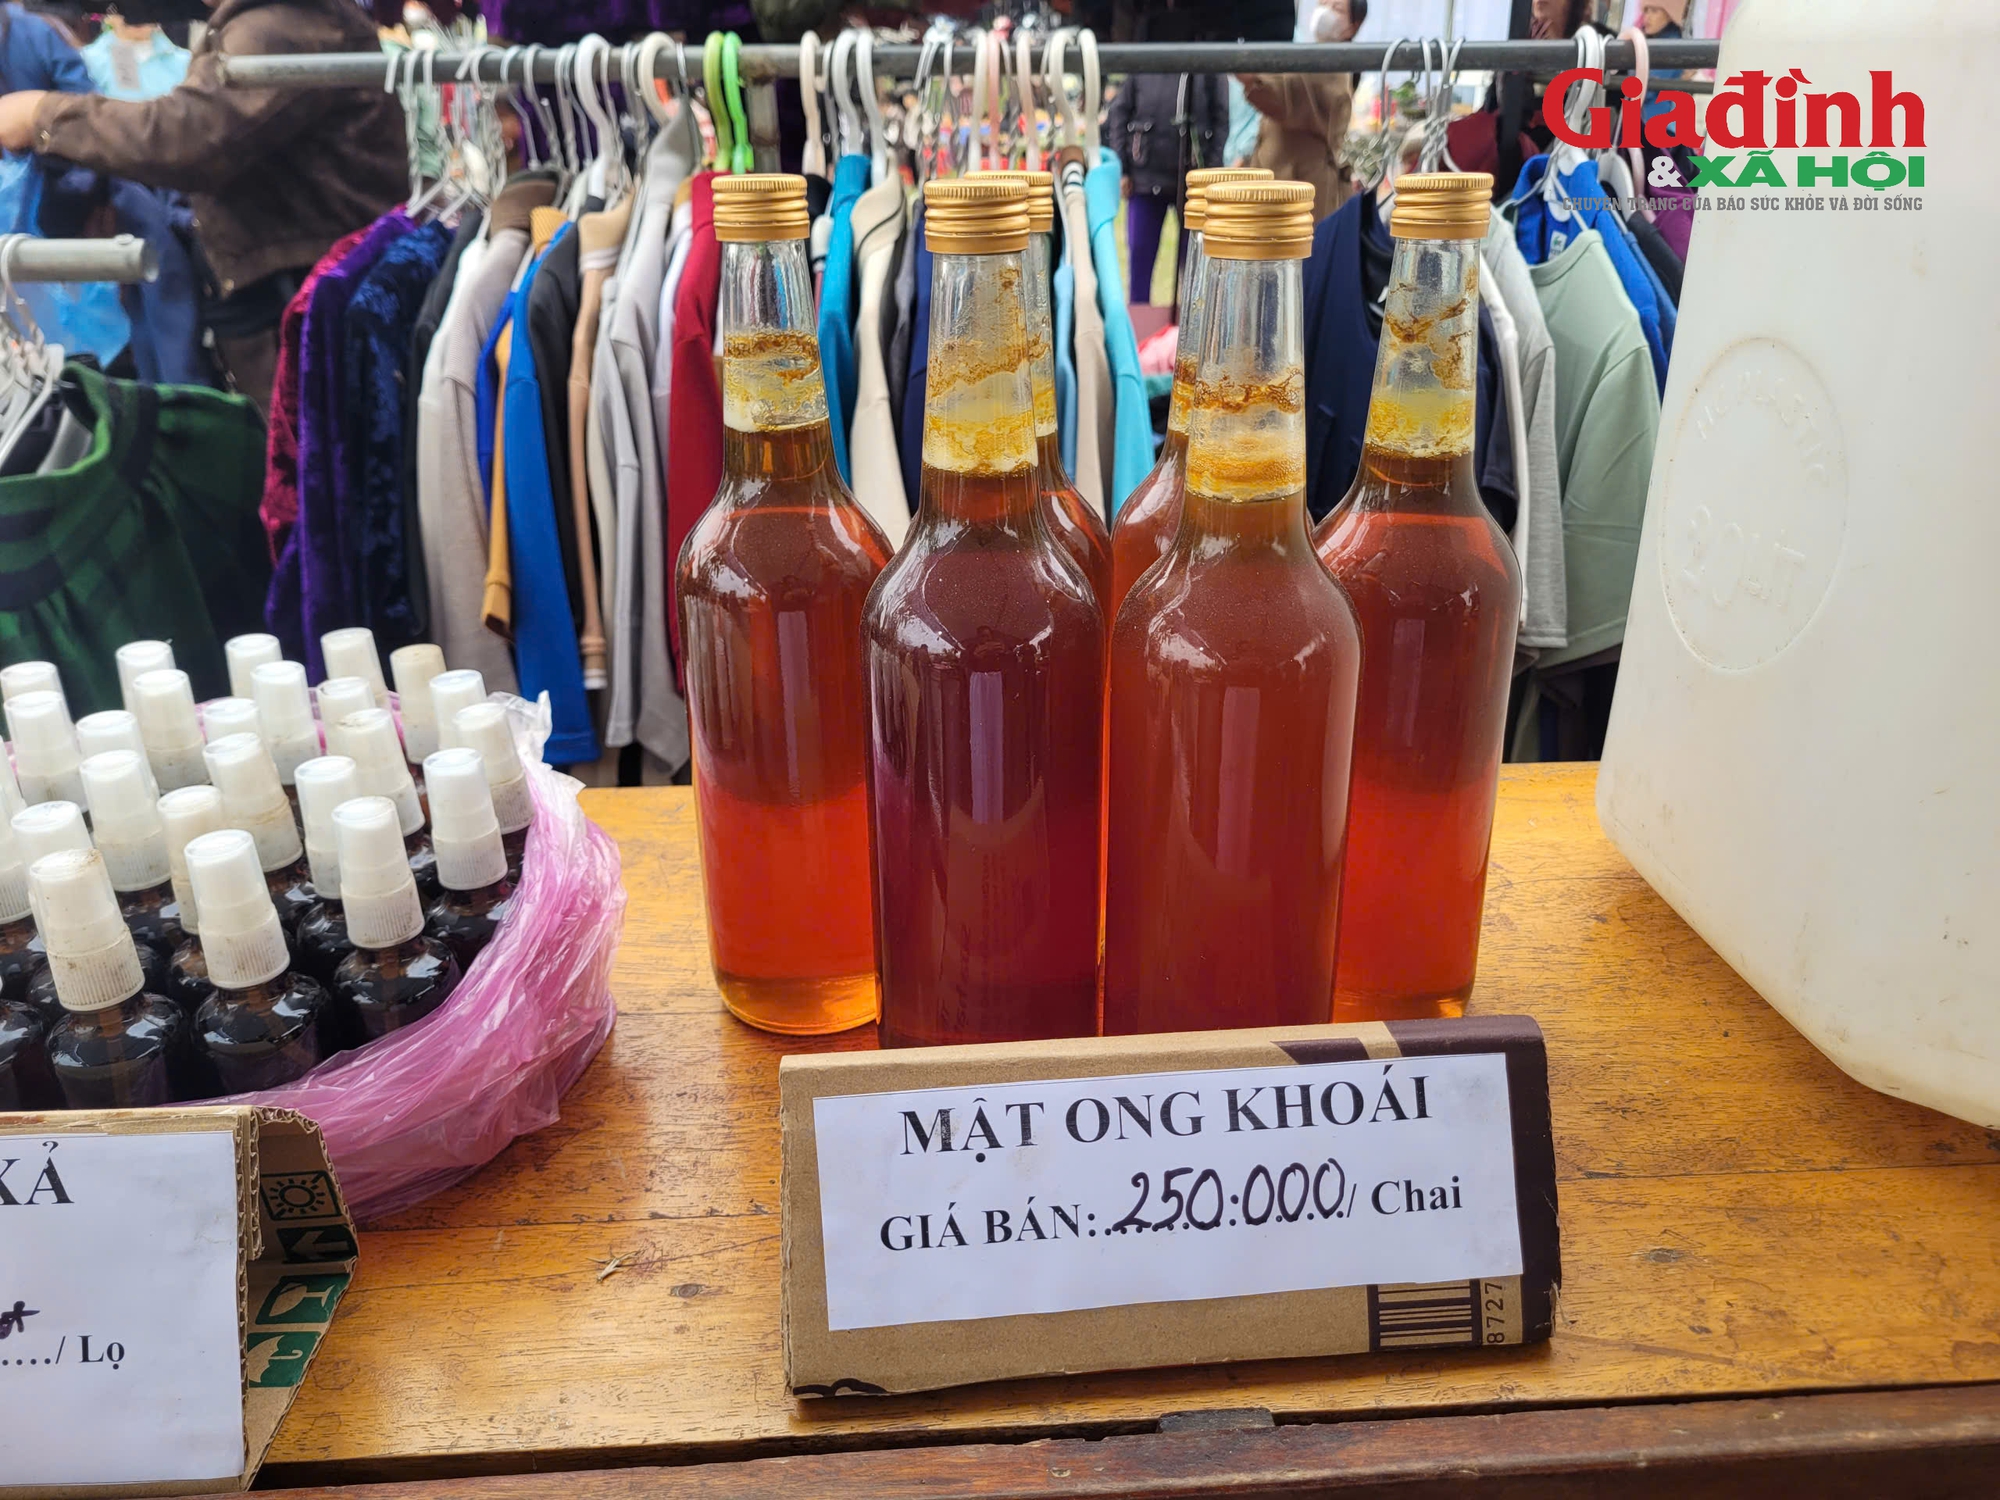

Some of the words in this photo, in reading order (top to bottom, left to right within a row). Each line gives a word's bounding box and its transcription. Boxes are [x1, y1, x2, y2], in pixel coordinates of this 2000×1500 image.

[899, 1097, 1046, 1163] MẬT
[1065, 1090, 1205, 1144] ONG
[1223, 1064, 1433, 1134] KHOÁI
[879, 1196, 968, 1252] GIÁ
[1371, 1175, 1464, 1216] Chai
[1484, 1281, 1506, 1344] 8727
[77, 1334, 125, 1370] Lọ
